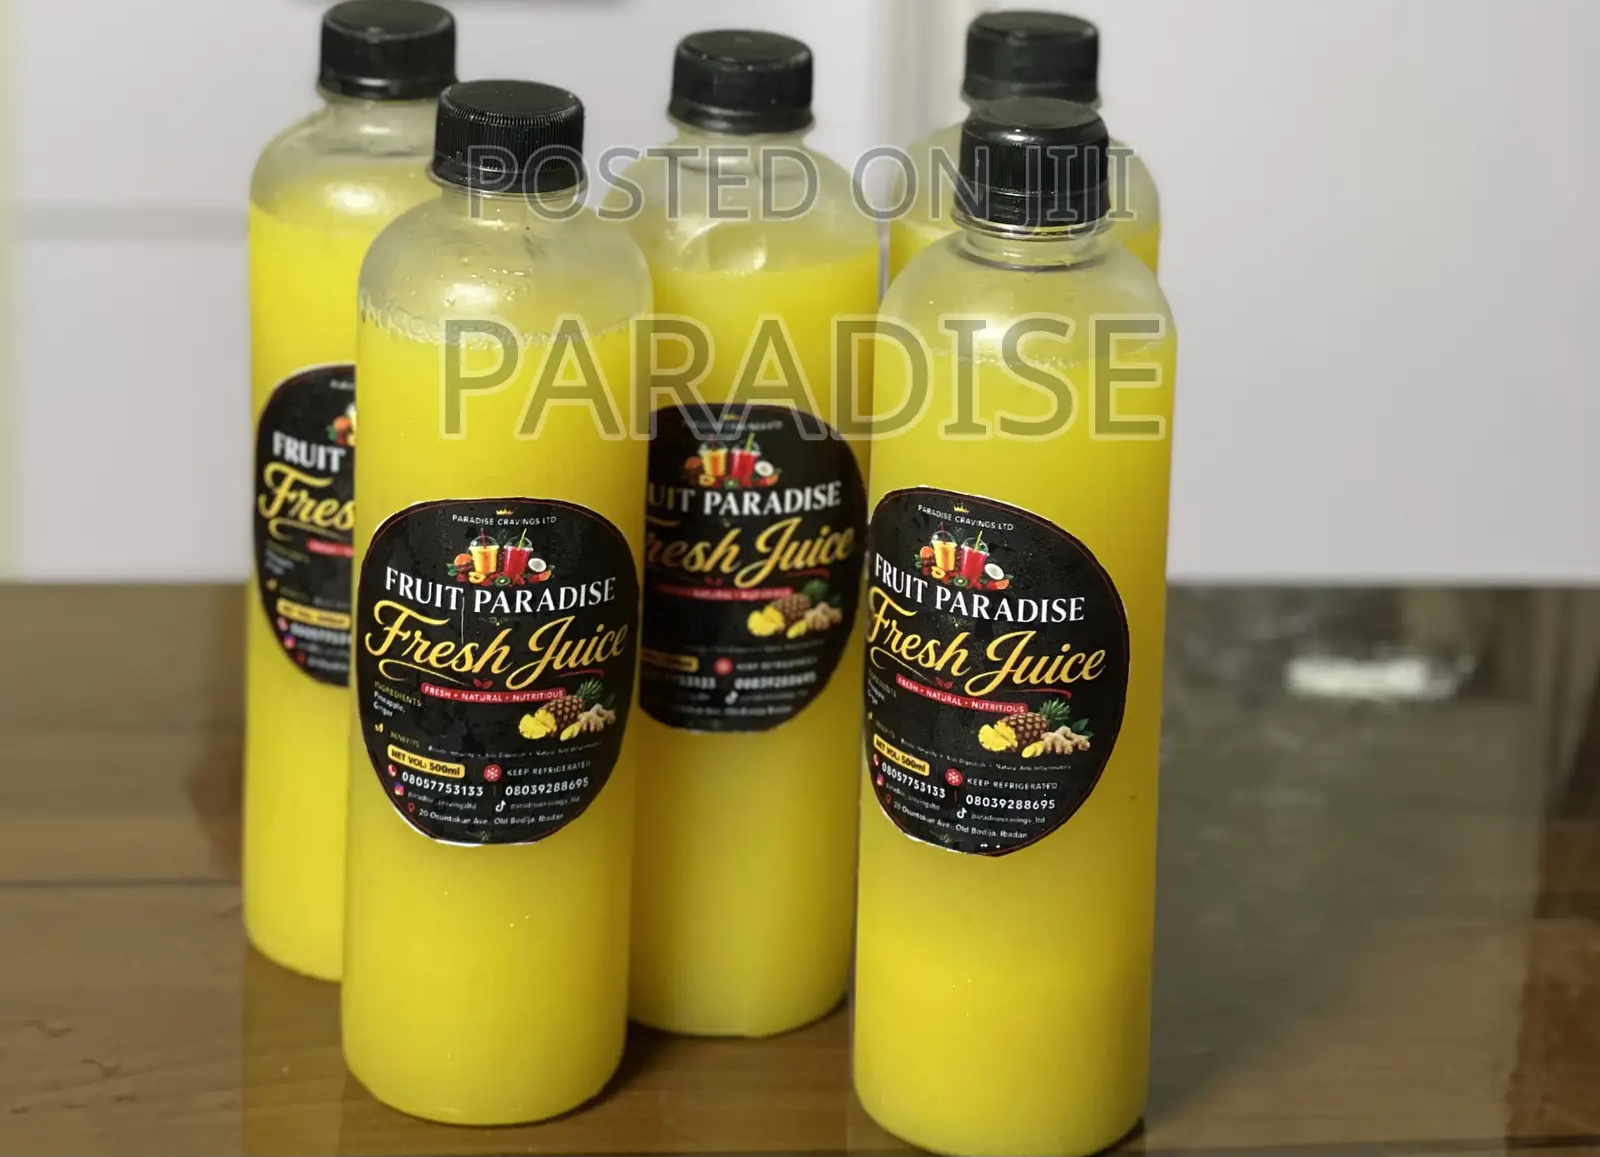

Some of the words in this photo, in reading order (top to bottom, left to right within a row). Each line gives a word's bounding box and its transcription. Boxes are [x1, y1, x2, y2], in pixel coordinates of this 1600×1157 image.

[273, 430, 347, 474] FRUIT
[258, 461, 355, 531] Fres
[648, 481, 696, 513] UIT
[703, 480, 842, 516] PARADISE
[452, 514, 494, 526] PARADISE
[497, 518, 540, 526] CRAVINGS
[542, 516, 557, 525] LTD
[917, 504, 953, 522] PARADISE
[954, 515, 996, 529] CRAVINGS
[998, 523, 1014, 531] LTD
[734, 516, 855, 589] Juice
[385, 566, 464, 610] FRUIT
[474, 577, 616, 614] PARADISE
[875, 552, 929, 603] FRUIT
[935, 584, 1086, 623] PARADISE
[364, 599, 513, 675] Fresh
[505, 615, 628, 691] Juice
[866, 585, 972, 677] Fresh
[964, 630, 1106, 697] Juice
[424, 685, 451, 698] FRESH
[461, 692, 502, 703] NATURAL
[512, 690, 563, 702] NUTRITIOUS
[898, 677, 919, 692] FRESH
[926, 689, 962, 706] NATURAL
[971, 701, 1024, 713] NUTRITIOUS
[391, 749, 406, 761] NET
[408, 755, 427, 768] VOL:
[429, 762, 460, 776] 500ml
[506, 768, 529, 777] KEEP
[532, 760, 592, 775] REFRIGERATED
[901, 756, 926, 773] 500ml
[401, 771, 484, 797] 08057753133
[505, 777, 589, 796] 08039288695
[881, 761, 946, 799] 08057753133
[966, 777, 990, 787] KEEP
[993, 781, 1058, 791] REFRIGERATED
[966, 794, 1056, 810] 08039288695
[955, 824, 969, 833] Old
[1000, 830, 1028, 839] Ibadan
